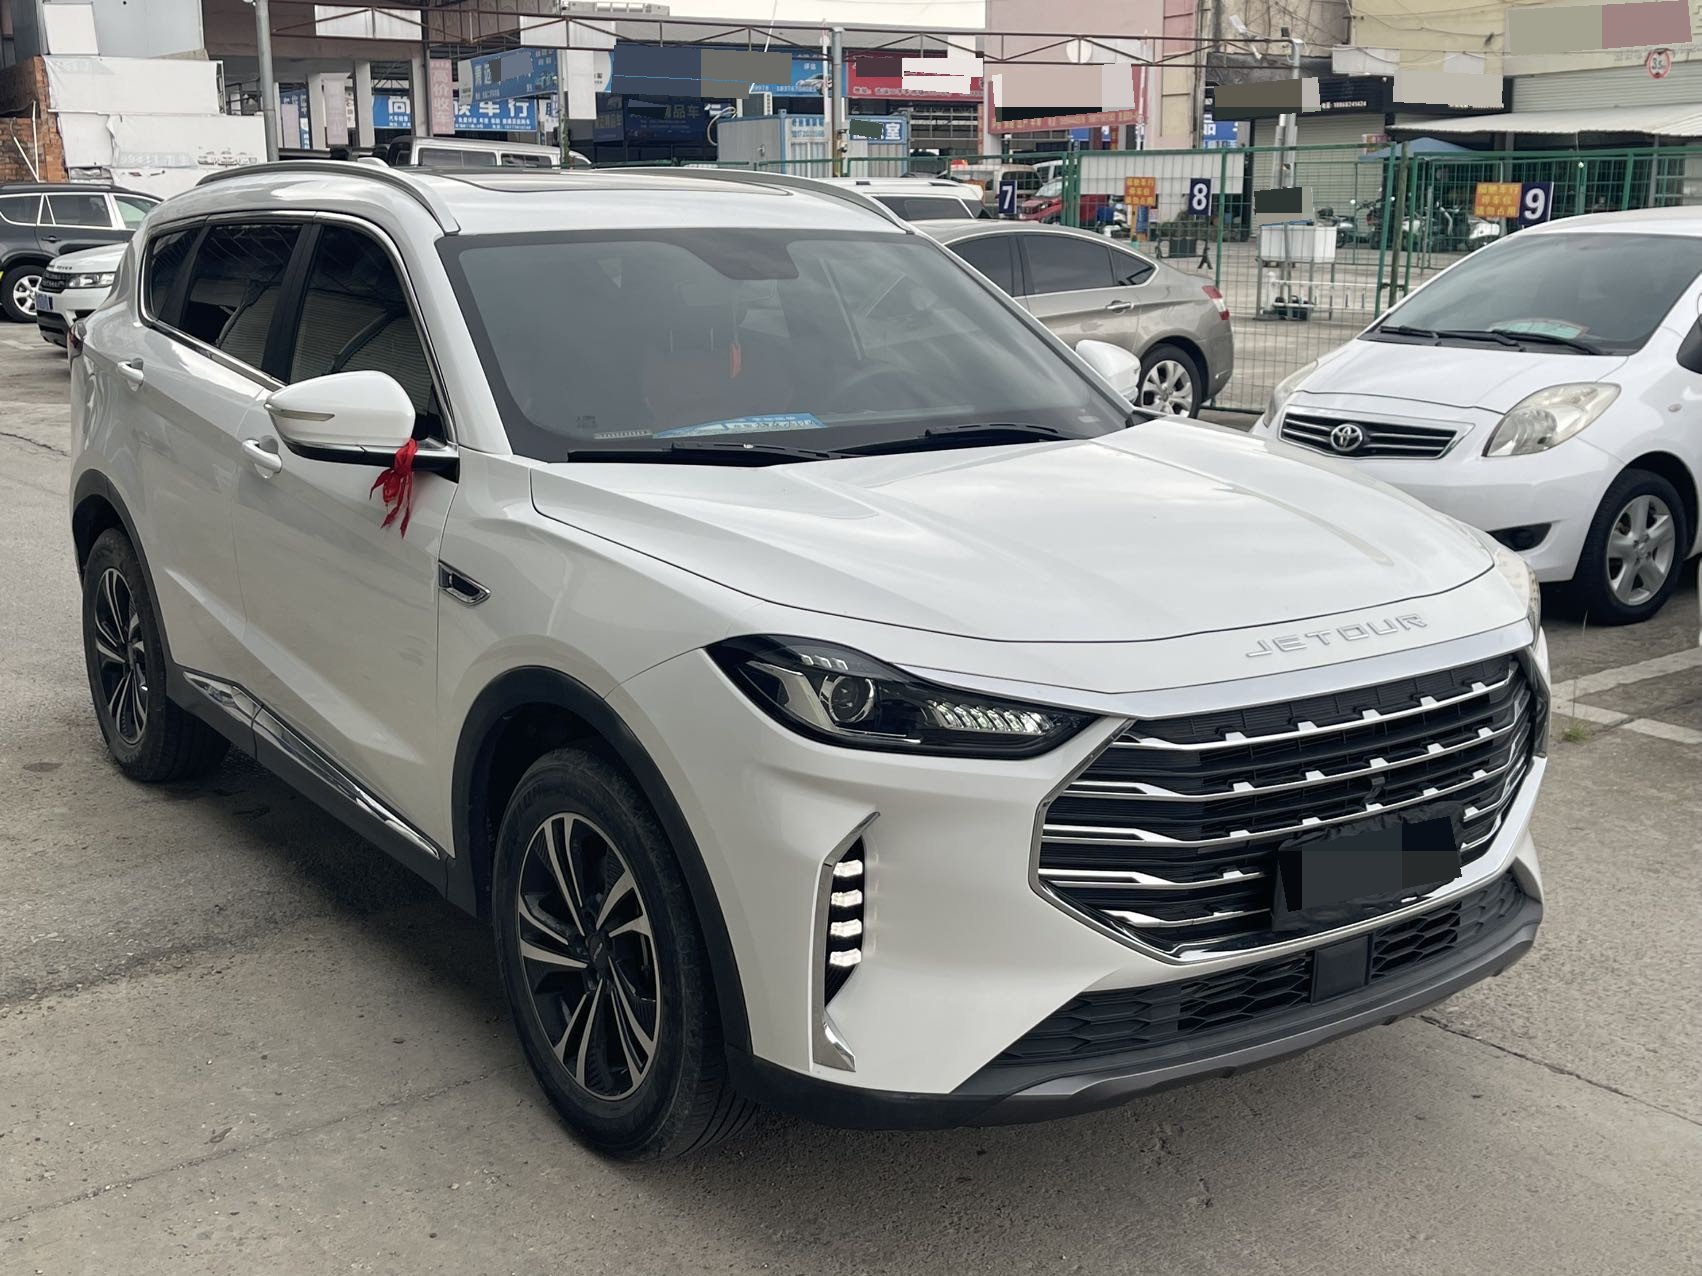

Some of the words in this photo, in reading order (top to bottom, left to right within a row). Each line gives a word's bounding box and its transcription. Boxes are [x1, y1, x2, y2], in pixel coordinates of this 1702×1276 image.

[1002, 185, 1013, 209] 7
[1192, 183, 1208, 211] 8
[1524, 187, 1546, 220] 9
[1246, 613, 1428, 658] JETOUR
